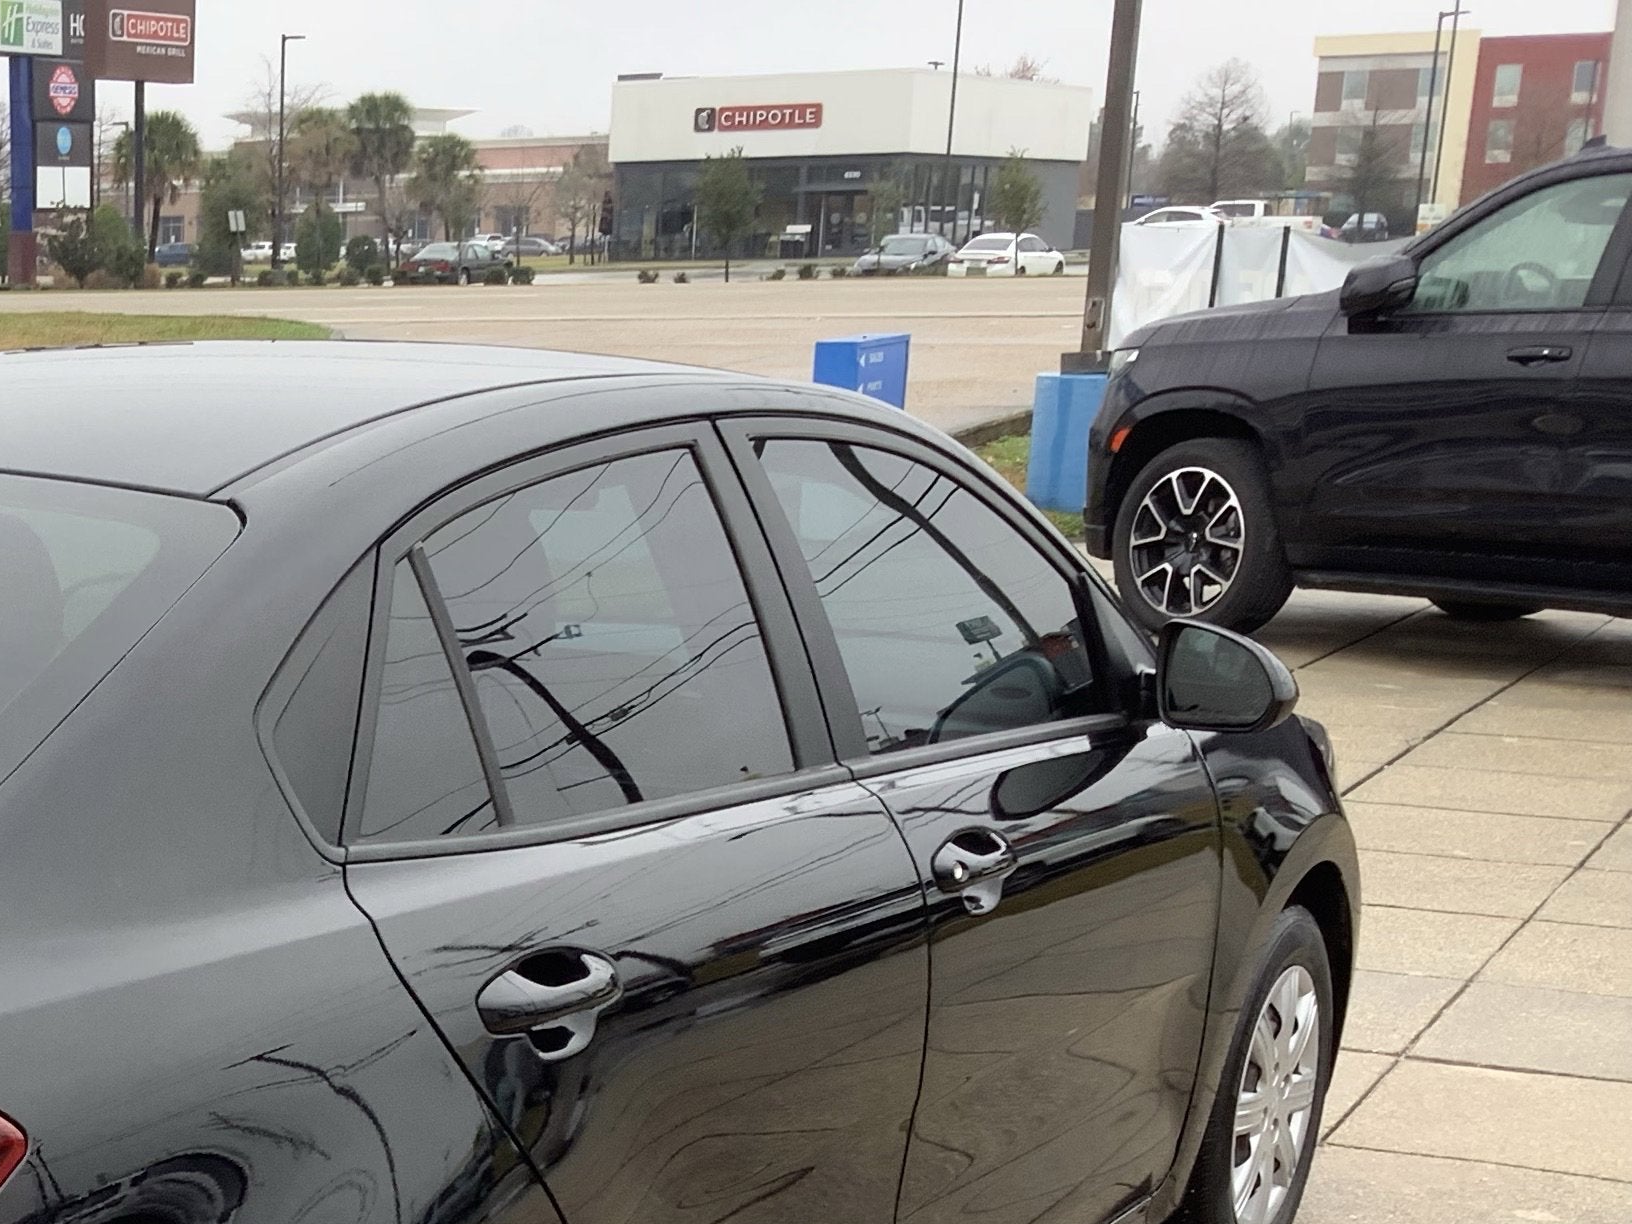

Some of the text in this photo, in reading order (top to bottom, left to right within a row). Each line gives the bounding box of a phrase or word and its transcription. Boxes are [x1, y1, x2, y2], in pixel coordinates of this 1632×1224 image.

[26, 16, 60, 36] Express
[128, 19, 186, 38] CHIPOTLE
[136, 46, 186, 57] MEXICAN GRILL
[720, 108, 817, 126] CHIPOTLE
